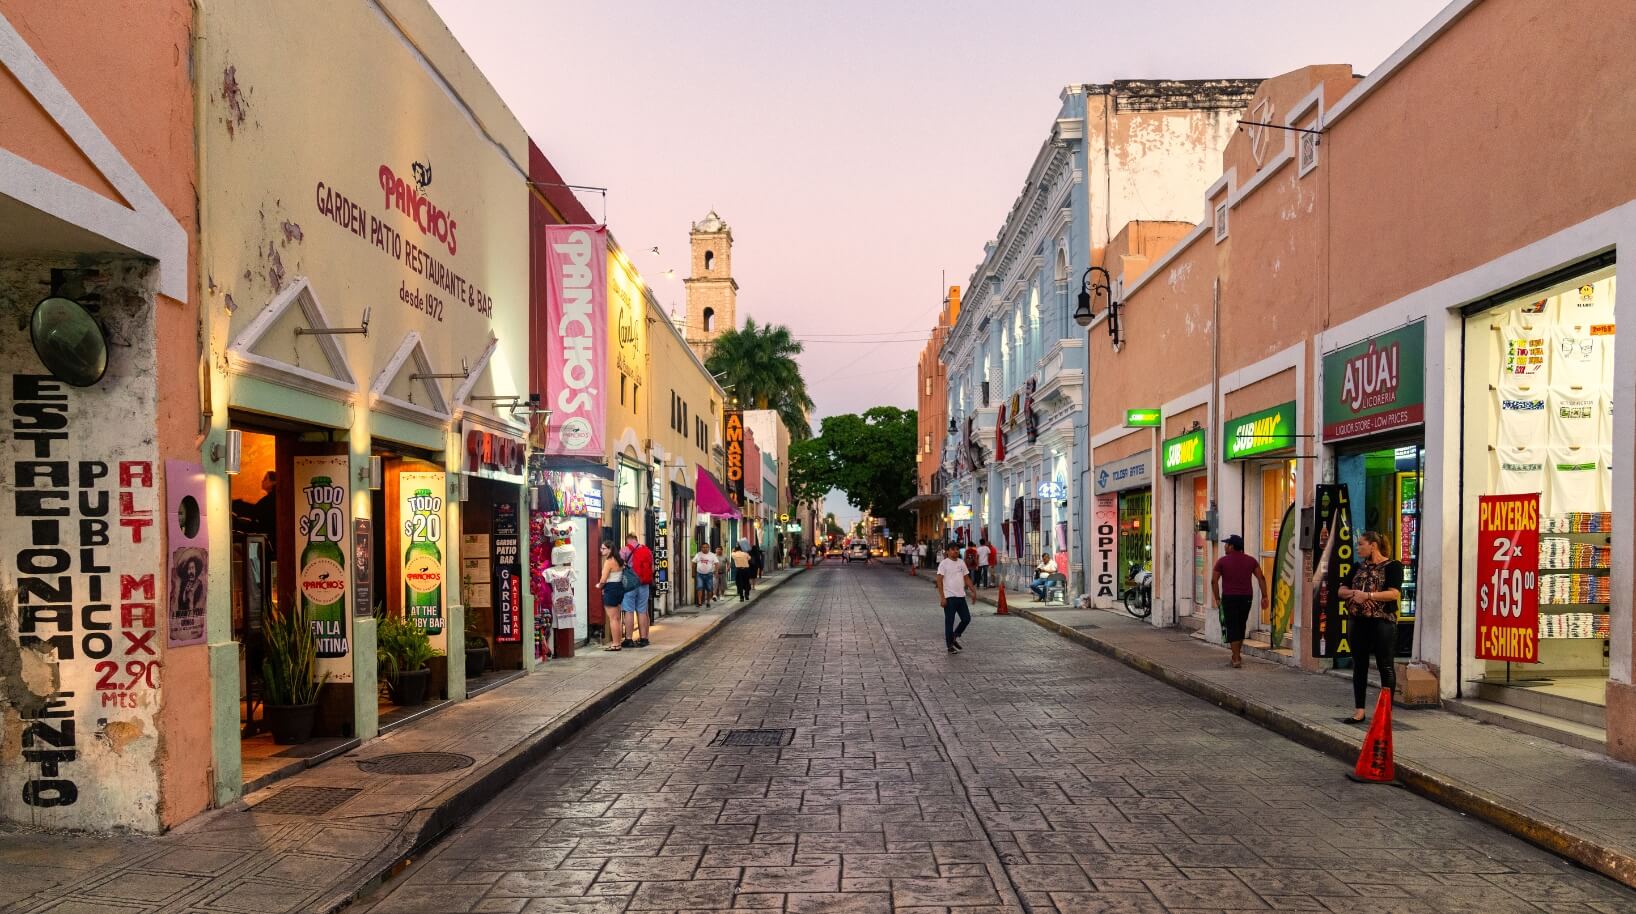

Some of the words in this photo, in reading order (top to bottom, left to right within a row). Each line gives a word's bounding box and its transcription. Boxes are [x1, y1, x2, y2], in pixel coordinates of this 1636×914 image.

[379, 165, 457, 256] PANCHO'S
[316, 181, 366, 239] GARDEN
[371, 215, 401, 260] PATIO
[405, 240, 466, 303] RESTAURANTE
[468, 284, 475, 307] &
[477, 290, 493, 320] BAR
[400, 280, 424, 312] desde
[425, 293, 443, 322] 1972
[552, 231, 597, 413] PANCHO'S
[1342, 345, 1397, 409] AJÚA!
[1233, 412, 1281, 453] SUBWAY
[1335, 423, 1354, 435] LIQUOR
[1355, 419, 1371, 432] STORE
[1374, 416, 1387, 429] LOW
[1388, 411, 1408, 425] PRICES
[727, 415, 742, 480] AMARO
[1167, 436, 1198, 467] SUBWAY
[119, 461, 155, 544] ALT
[304, 487, 344, 506] TODO
[408, 497, 441, 512] TODO
[301, 507, 343, 542] $20
[405, 514, 441, 542] $20
[1481, 500, 1536, 531] PLAYERAS
[79, 461, 112, 659] PUBLICO
[496, 546, 517, 555] PATIO
[500, 555, 515, 564] BAR
[1098, 521, 1113, 597] ÓPTICA
[303, 580, 345, 590] PANCHO'S
[1337, 489, 1351, 652] LICORRIA
[13, 374, 78, 807] ESTACIONAMENTO
[501, 570, 511, 634] GARDEN
[120, 574, 156, 655] MAX
[326, 620, 341, 635] LA
[411, 606, 421, 616] AT
[423, 606, 437, 616] THE
[429, 617, 445, 629] BAR
[316, 638, 349, 653] NTINA
[1480, 626, 1533, 659] T-SHIRTS
